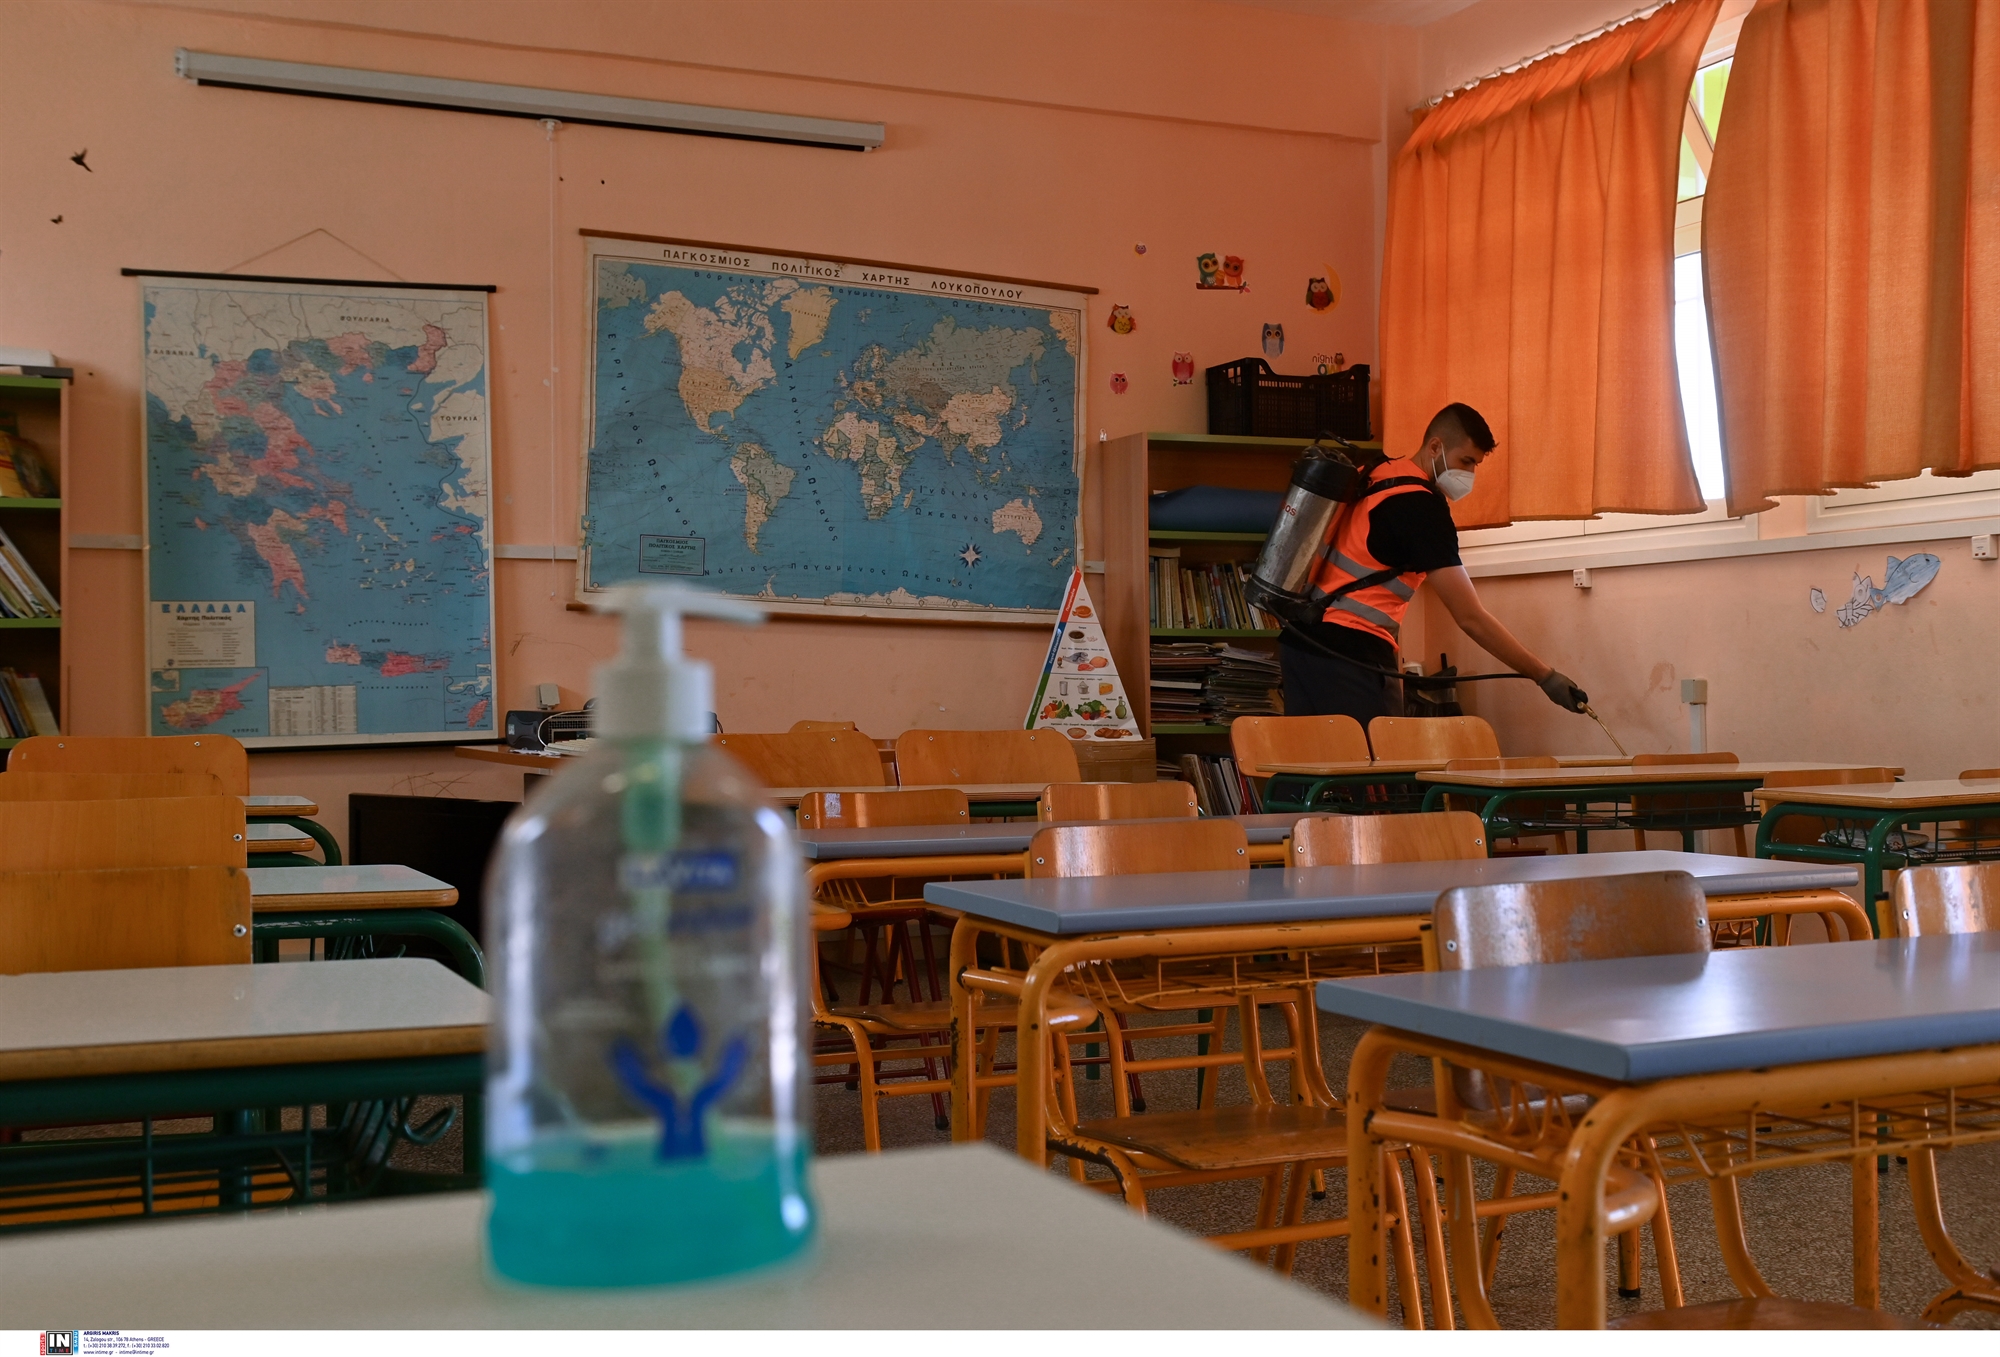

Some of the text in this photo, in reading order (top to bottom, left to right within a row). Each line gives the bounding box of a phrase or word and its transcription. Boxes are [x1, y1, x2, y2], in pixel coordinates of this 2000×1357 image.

[663, 249, 1024, 300] ΠΑΓΚΟΣΜΙΟΣ ΠΟΛΙΤΙΚΟΣ ΧΑΡΤΗΣ ΛΟΥΚΟΠΟΥΛΟΥ
[828, 286, 900, 302] Παγωμένος
[952, 301, 1027, 317] Ωκεανός
[1312, 353, 1334, 365] night
[646, 457, 697, 538] Ωκεανός
[919, 485, 989, 502] Ινδικός
[807, 476, 839, 542] Ωκεανός
[914, 507, 989, 524] Ωκεανός
[704, 563, 768, 577] Νότιος
[790, 562, 886, 576] Παγωμένος
[161, 603, 247, 614] ΕΛΛΑΔΑ
